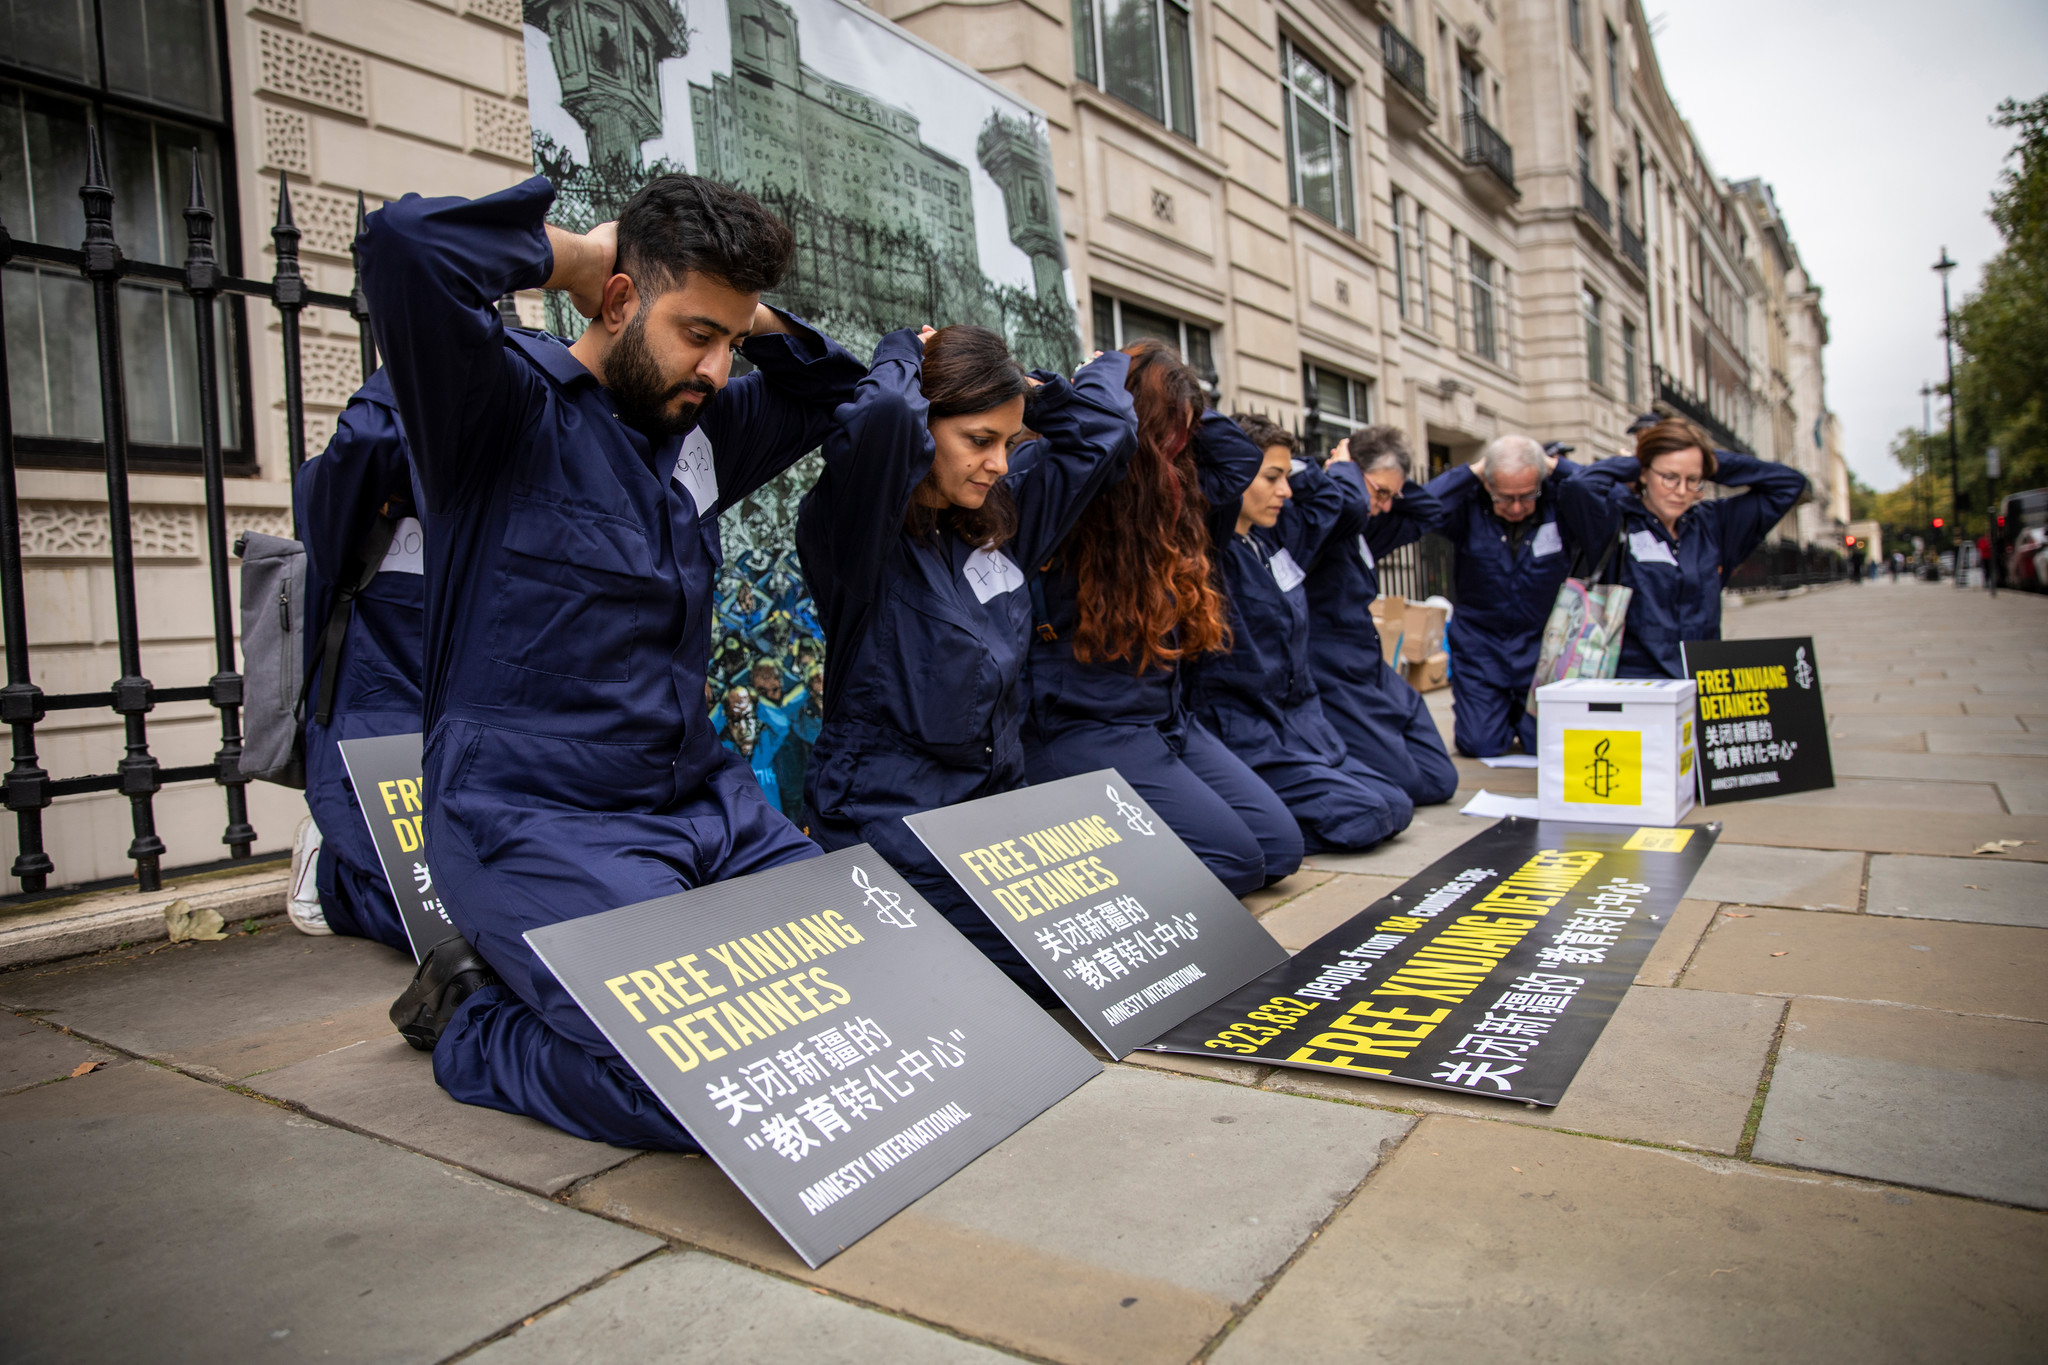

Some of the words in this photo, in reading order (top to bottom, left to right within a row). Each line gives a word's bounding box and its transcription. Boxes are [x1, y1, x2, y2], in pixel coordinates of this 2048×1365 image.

[1695, 670, 1732, 695] FREE
[1732, 665, 1789, 693] XINJIANG
[1699, 691, 1770, 721] DETAINEES
[1705, 720, 1773, 748] 关闭新疆的
[959, 840, 1037, 886] FREE
[1020, 814, 1123, 866] XINJIANG
[991, 856, 1120, 923] DETAINEES
[604, 953, 727, 1023] FREE
[705, 909, 865, 989] XINJIANG
[1033, 894, 1150, 962] 关闭新疆的
[1062, 911, 1200, 991] "教育转化中心"
[1204, 996, 1321, 1054] 323,832
[1294, 959, 1373, 1002] people
[1340, 933, 1408, 960] from
[1374, 915, 1430, 934] 184
[1407, 880, 1477, 917] countries
[1285, 1000, 1453, 1075] FREE
[1370, 915, 1539, 1004] XINJIANG
[1471, 849, 1605, 916] DETAINEES
[646, 966, 852, 1074] DETAINEES
[1101, 993, 1147, 1027] AMNESTY
[1142, 963, 1206, 1005] INTERNATIONAL
[704, 1015, 893, 1128] 关闭新疆的
[743, 1028, 967, 1164] "教育转化中心"
[797, 1160, 877, 1217] AMNESTY
[869, 1101, 972, 1176] INTERNATIONAL
